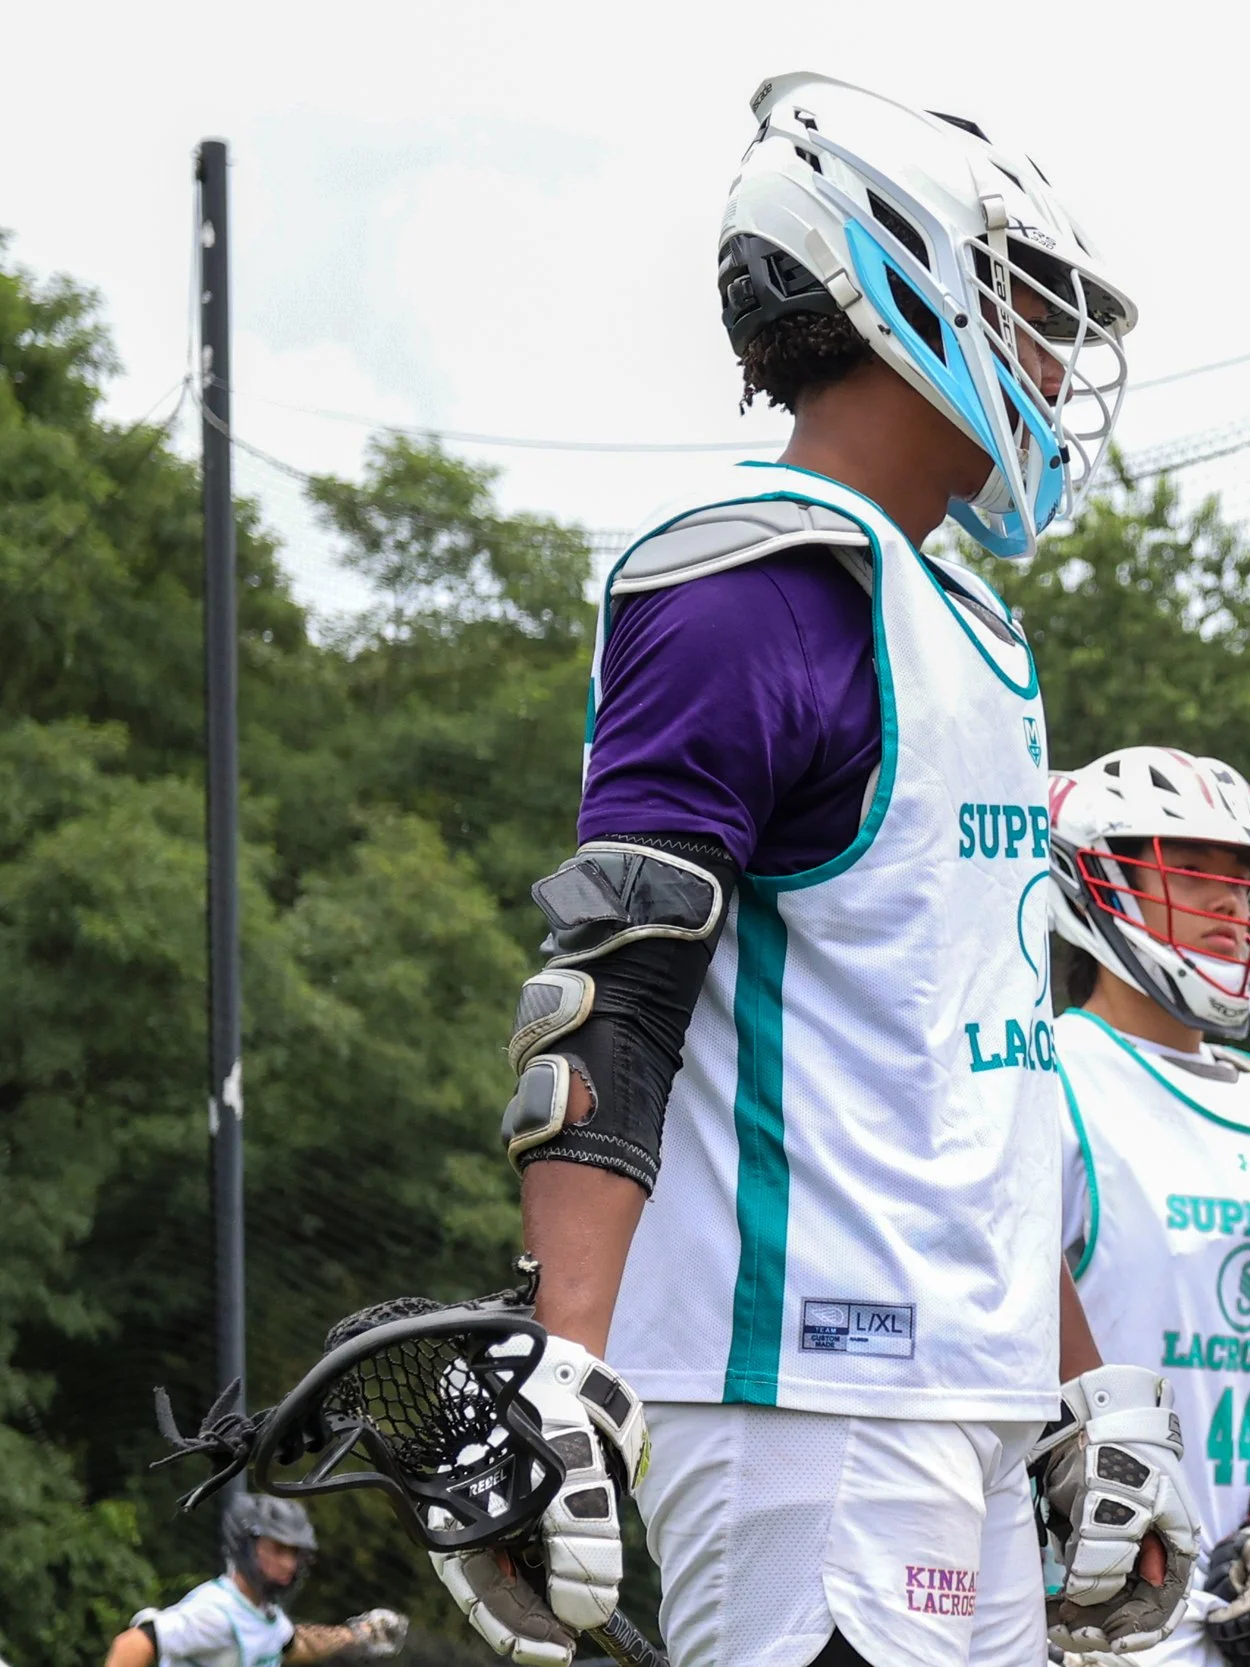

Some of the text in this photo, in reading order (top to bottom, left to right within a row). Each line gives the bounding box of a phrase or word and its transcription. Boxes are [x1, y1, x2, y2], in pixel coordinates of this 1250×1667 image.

[959, 802, 1050, 859] SUPR
[856, 1312, 903, 1333] L/XL
[905, 1566, 980, 1593] KINKA
[906, 1589, 977, 1617] LACROS
